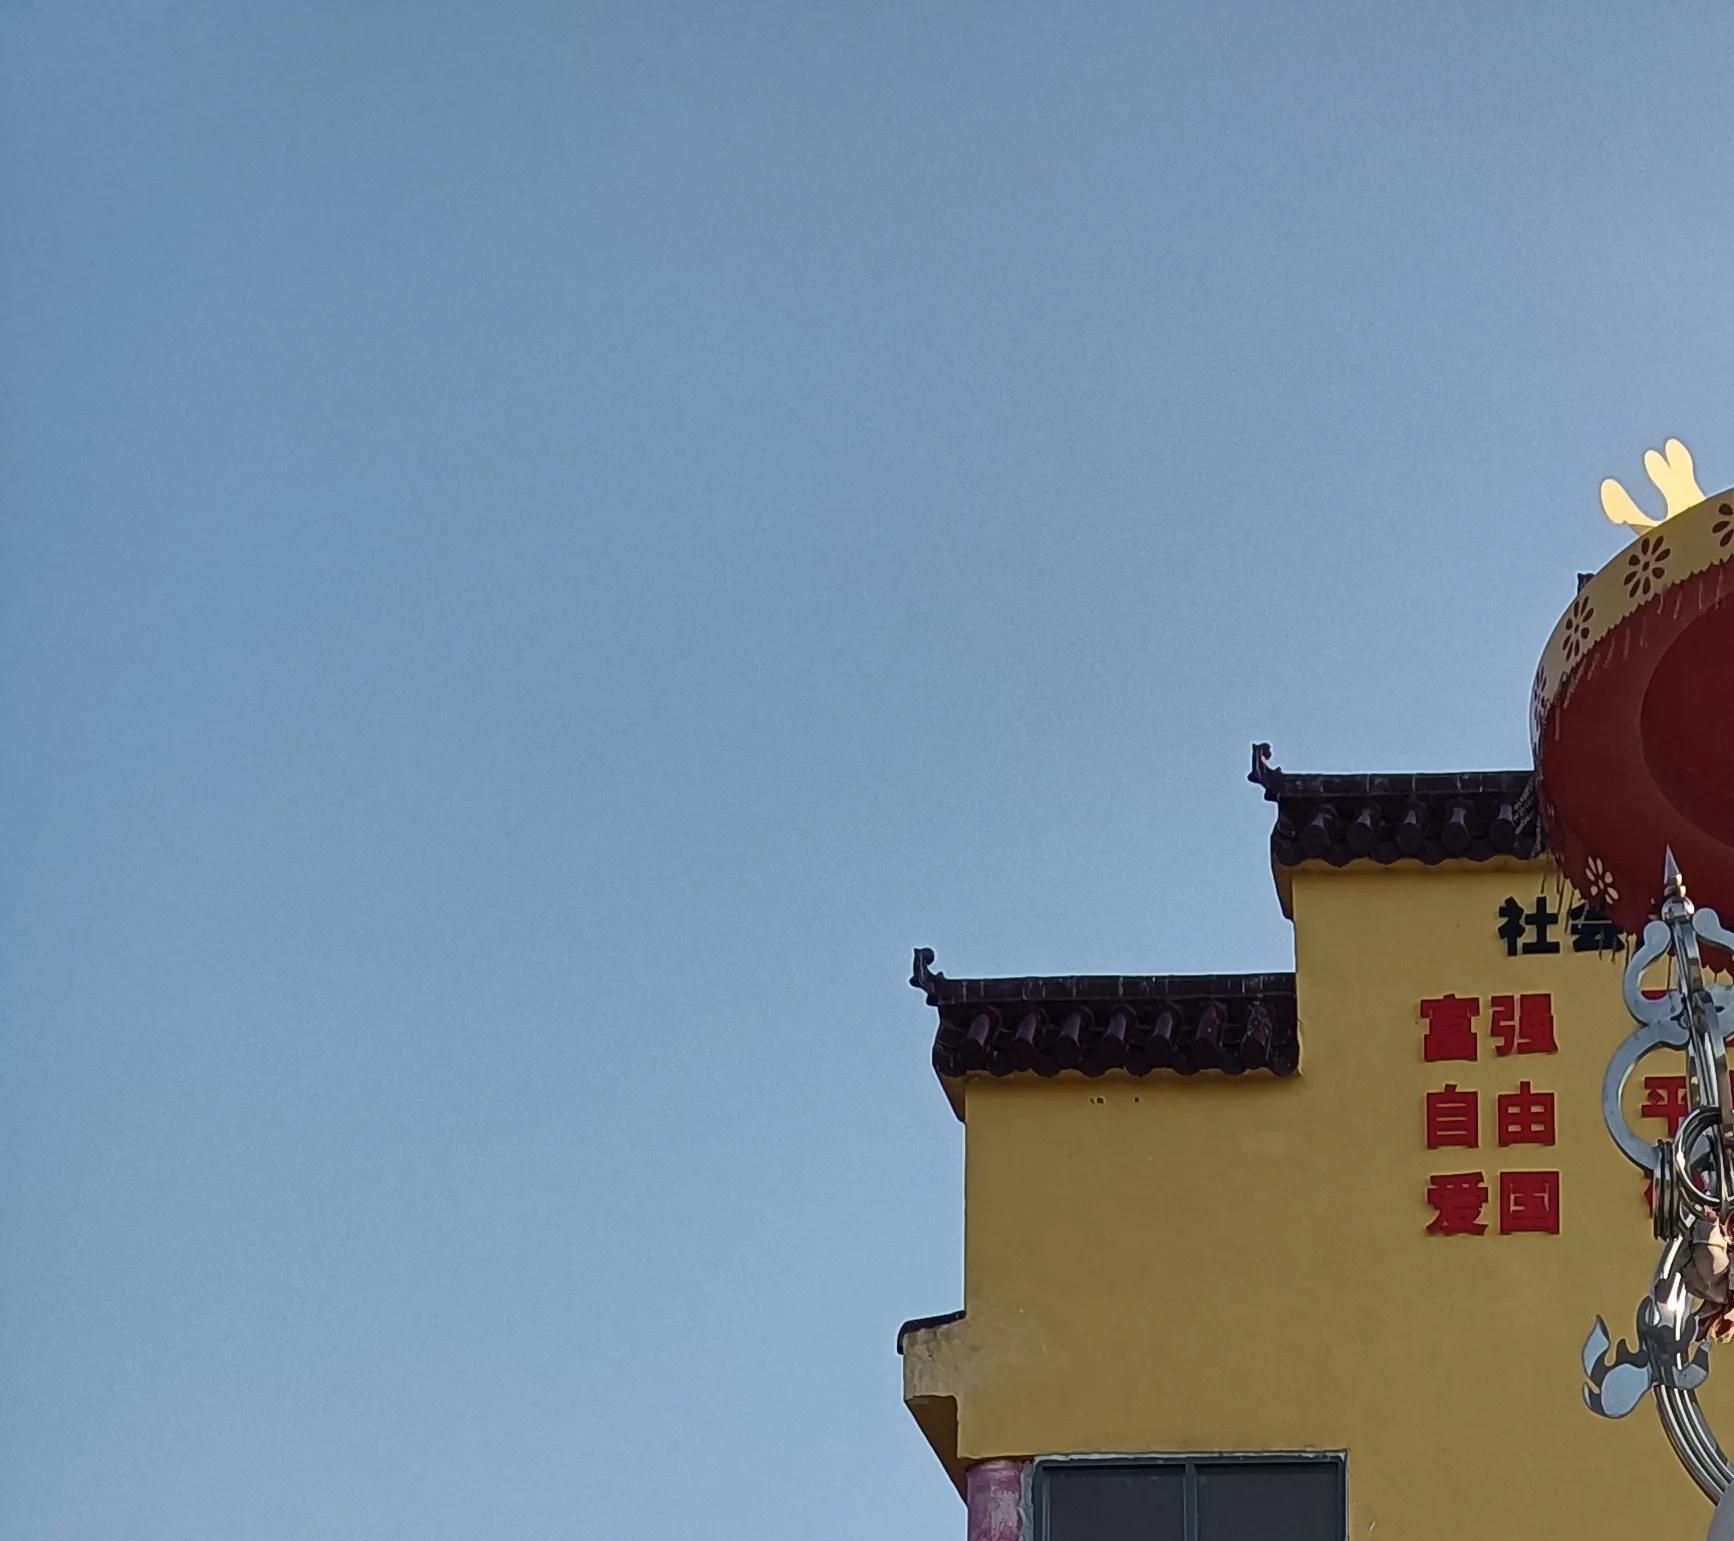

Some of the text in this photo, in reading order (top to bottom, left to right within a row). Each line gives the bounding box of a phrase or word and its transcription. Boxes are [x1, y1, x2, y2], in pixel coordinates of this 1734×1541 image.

[1419, 993, 1559, 1063] 富强
[1425, 1080, 1557, 1149] 自由
[1425, 1170, 1561, 1236] 爱国
